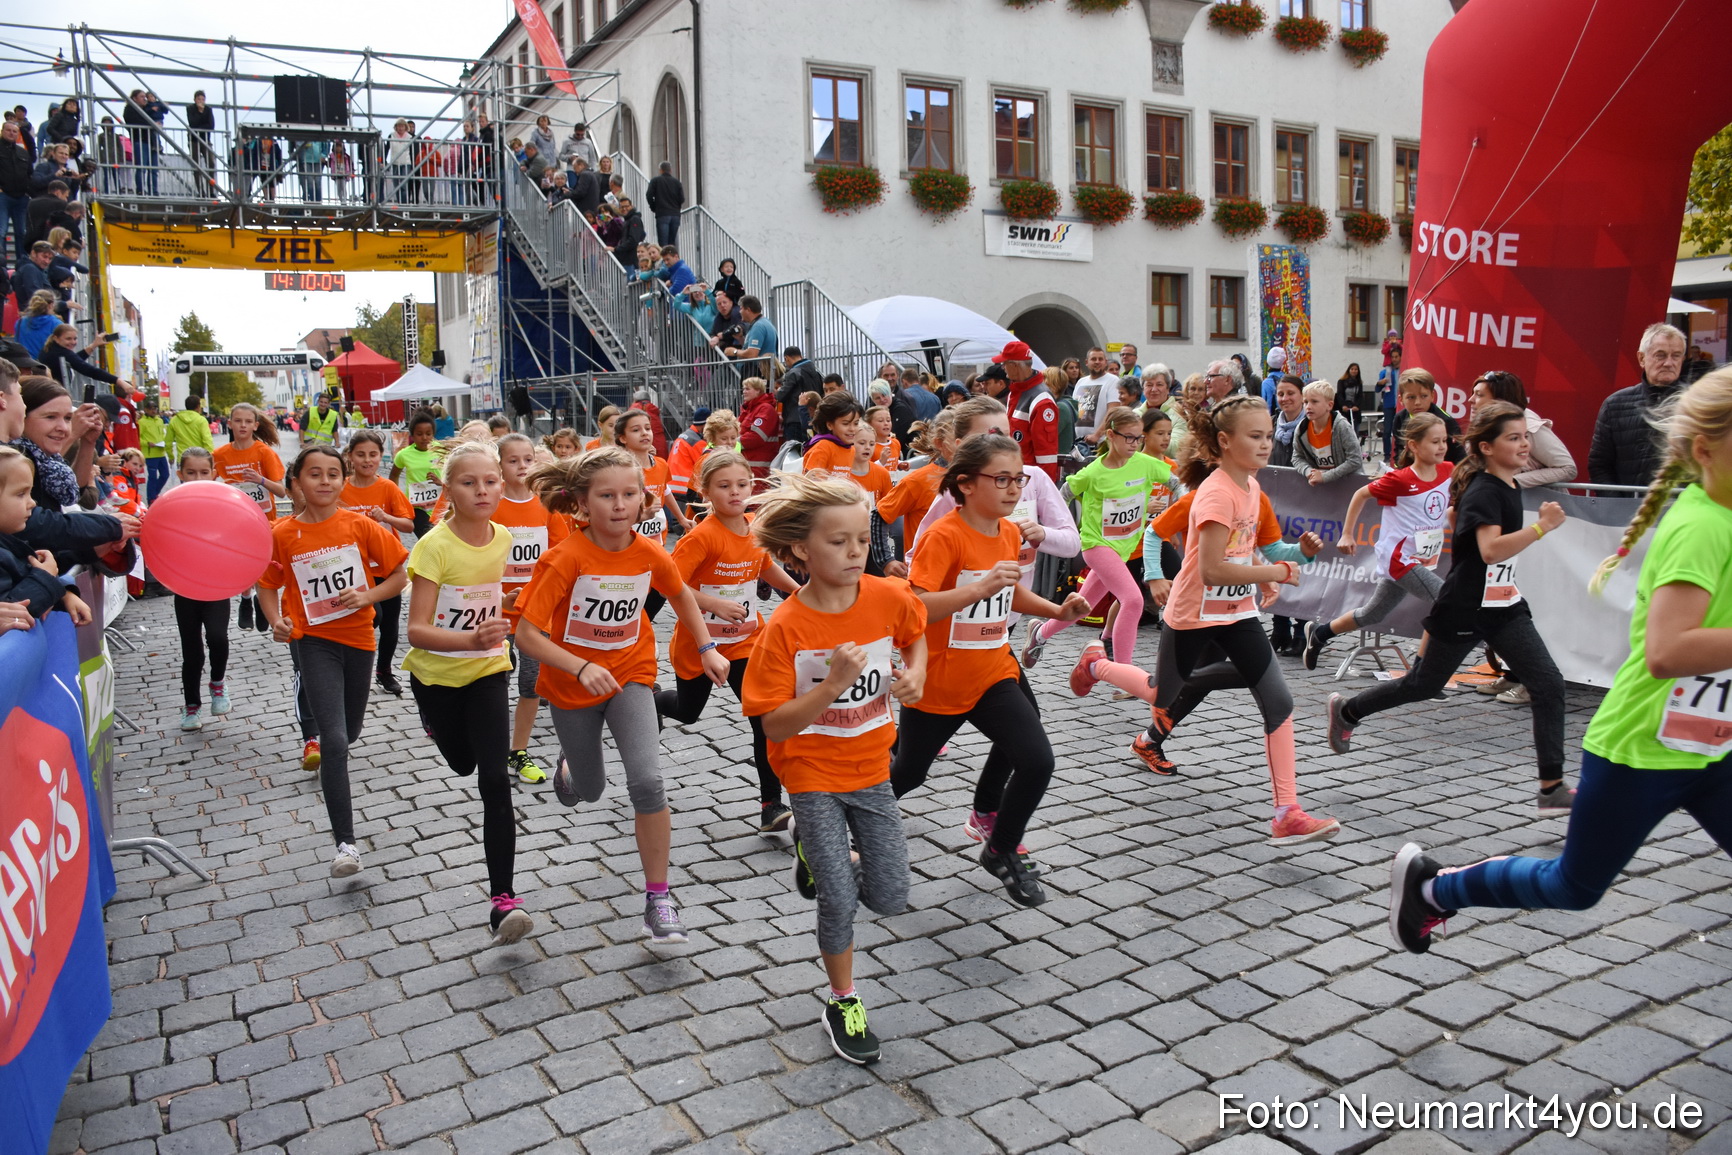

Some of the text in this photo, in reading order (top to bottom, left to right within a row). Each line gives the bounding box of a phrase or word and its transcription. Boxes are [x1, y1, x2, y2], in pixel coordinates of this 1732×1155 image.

[1008, 225, 1051, 242] swn
[255, 237, 335, 264] ZIEL
[1417, 221, 1520, 267] STORE
[1412, 298, 1537, 350] ONLINE
[203, 355, 229, 365] MINI
[414, 489, 438, 502] 7123
[1110, 505, 1140, 525] 7037
[292, 545, 339, 562] Neumarkter
[513, 566, 532, 574] Emma
[307, 566, 354, 598] 7167
[607, 582, 635, 590] BOCK
[584, 597, 639, 622] 7069
[593, 628, 625, 638] Victoria
[722, 626, 739, 635] Katja
